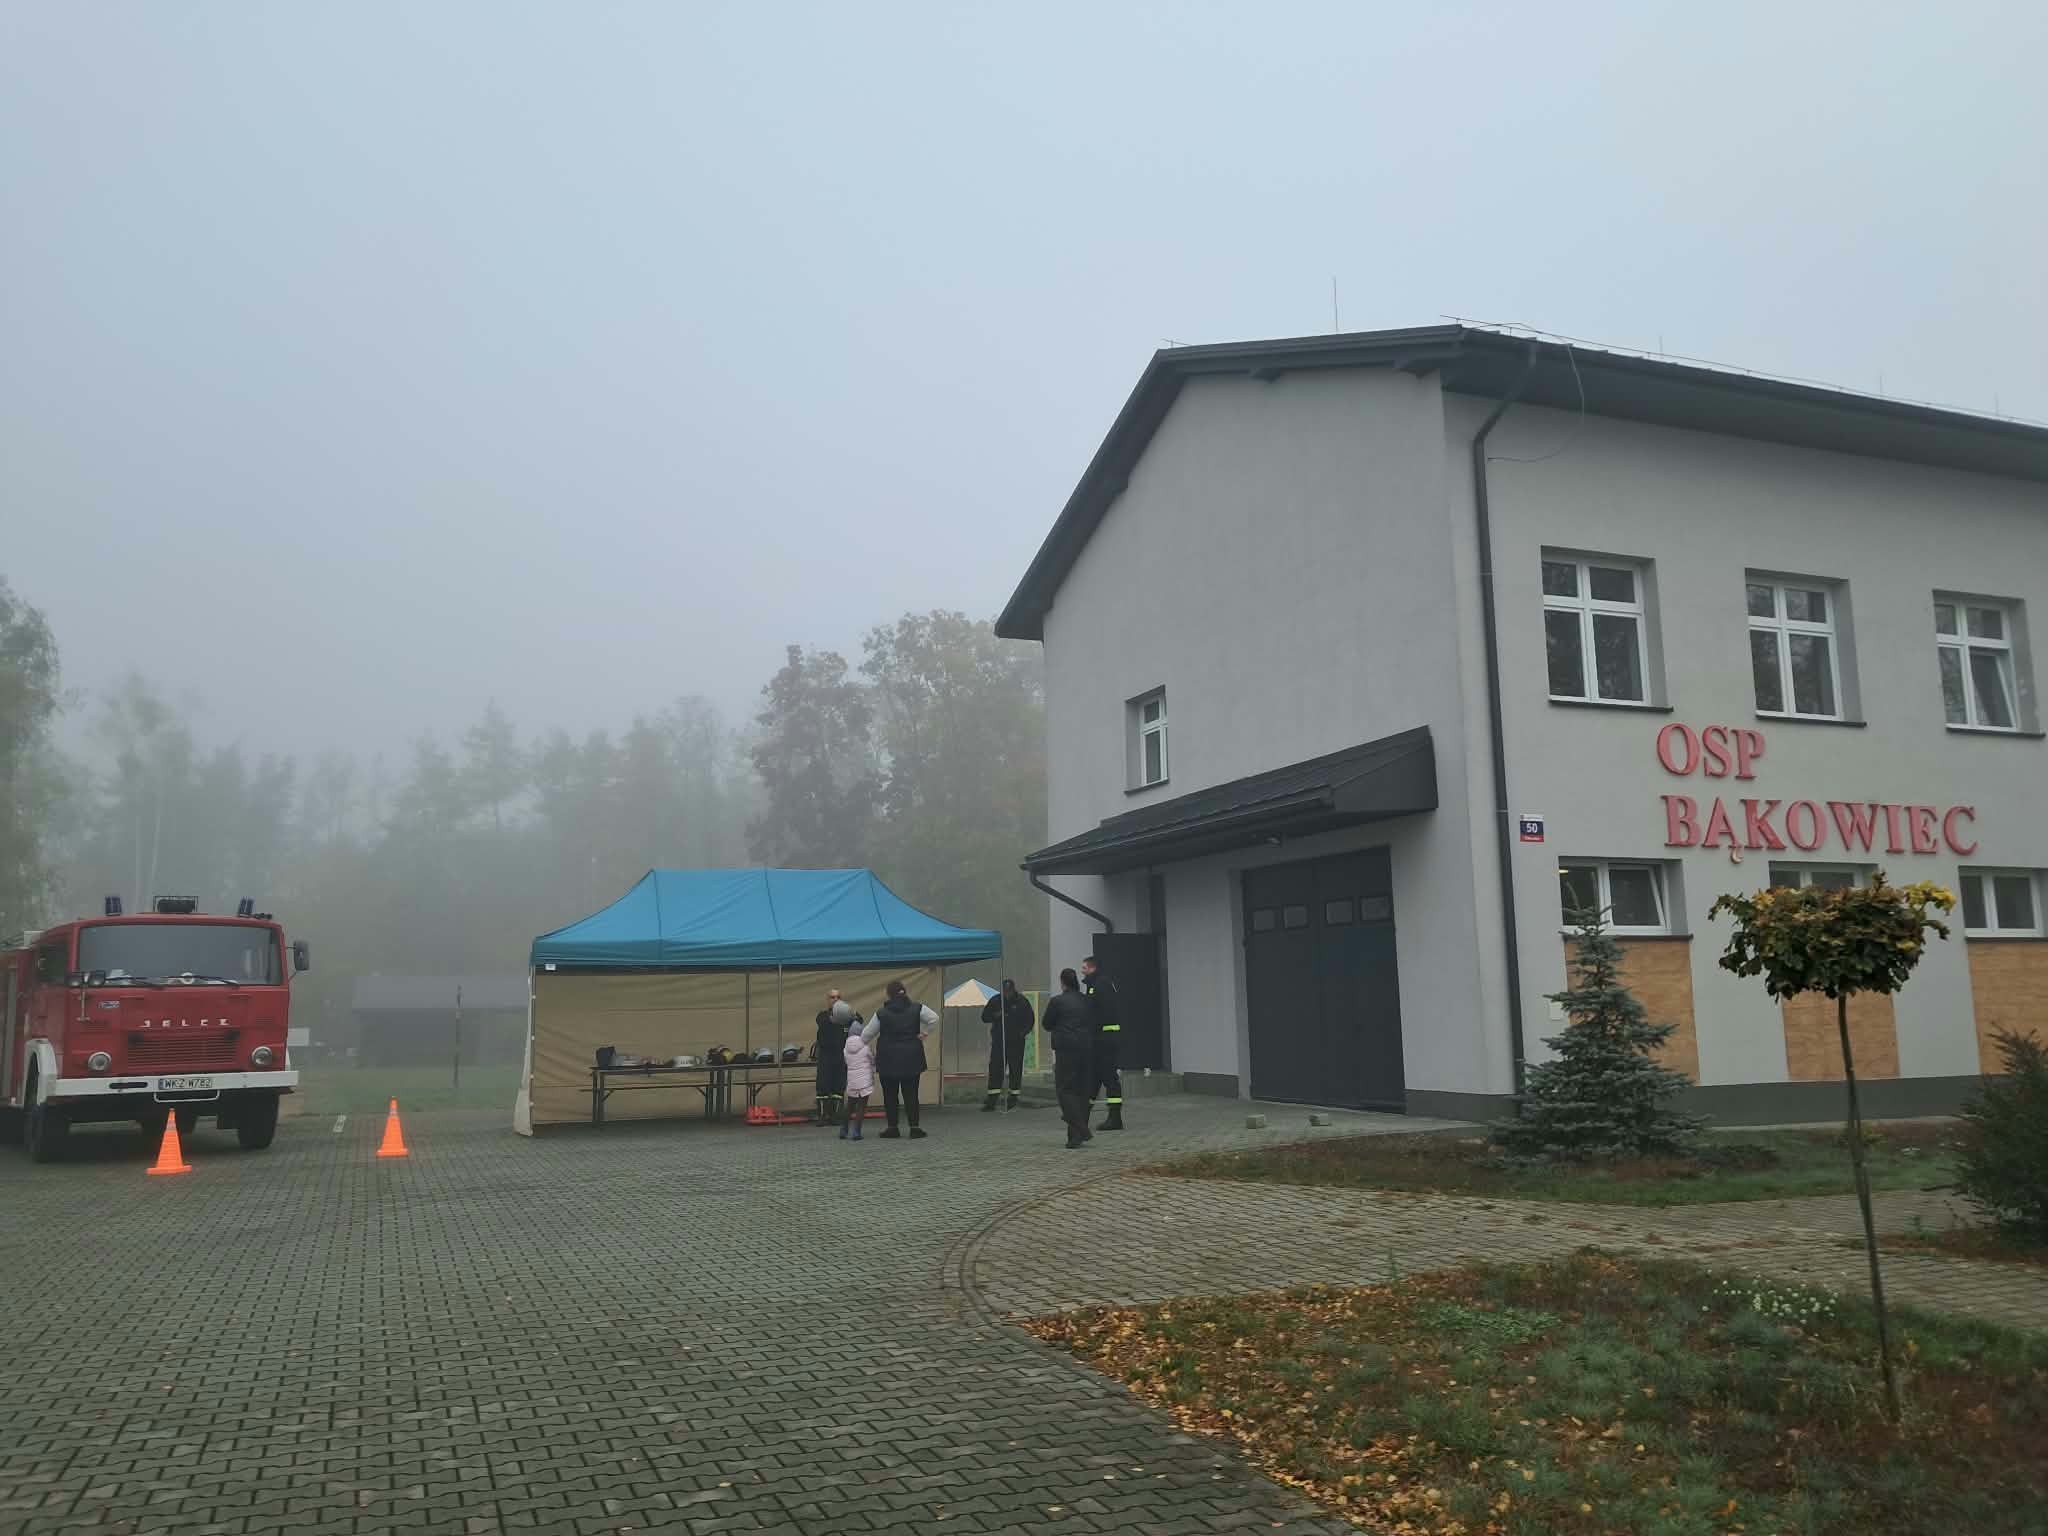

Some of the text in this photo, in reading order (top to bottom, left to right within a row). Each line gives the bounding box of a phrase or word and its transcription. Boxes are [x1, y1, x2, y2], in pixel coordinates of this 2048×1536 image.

[1656, 722, 1766, 780] OSP
[1526, 822, 1538, 833] 50
[1661, 795, 1978, 864] BĄKOWIEC
